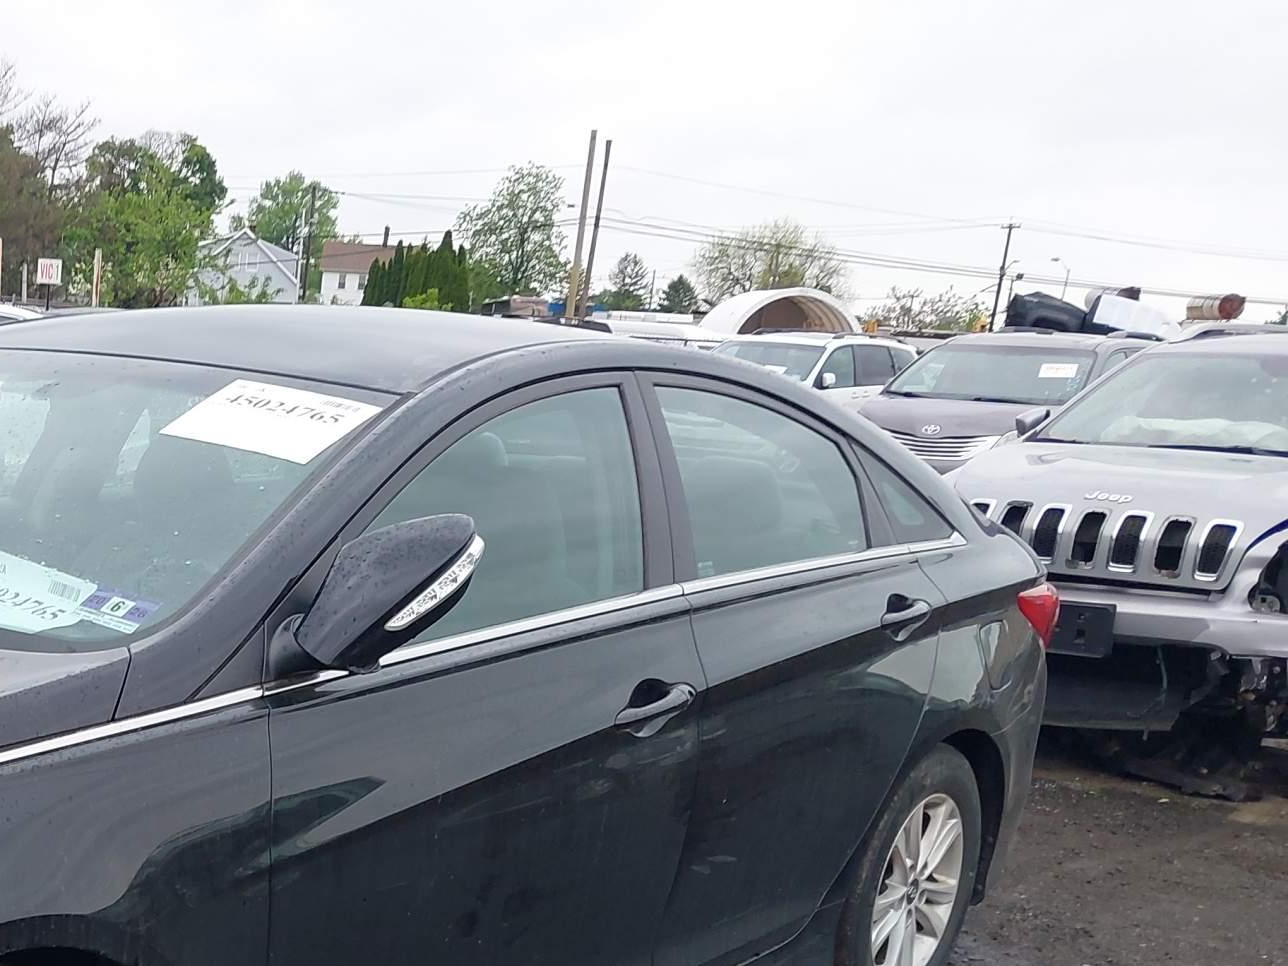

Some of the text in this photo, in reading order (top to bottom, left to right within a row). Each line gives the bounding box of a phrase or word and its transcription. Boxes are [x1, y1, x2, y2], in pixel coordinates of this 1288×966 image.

[40, 262, 54, 280] VIC
[225, 393, 346, 425] 45024765
[1083, 489, 1134, 505] Jeep
[110, 600, 126, 613] 6
